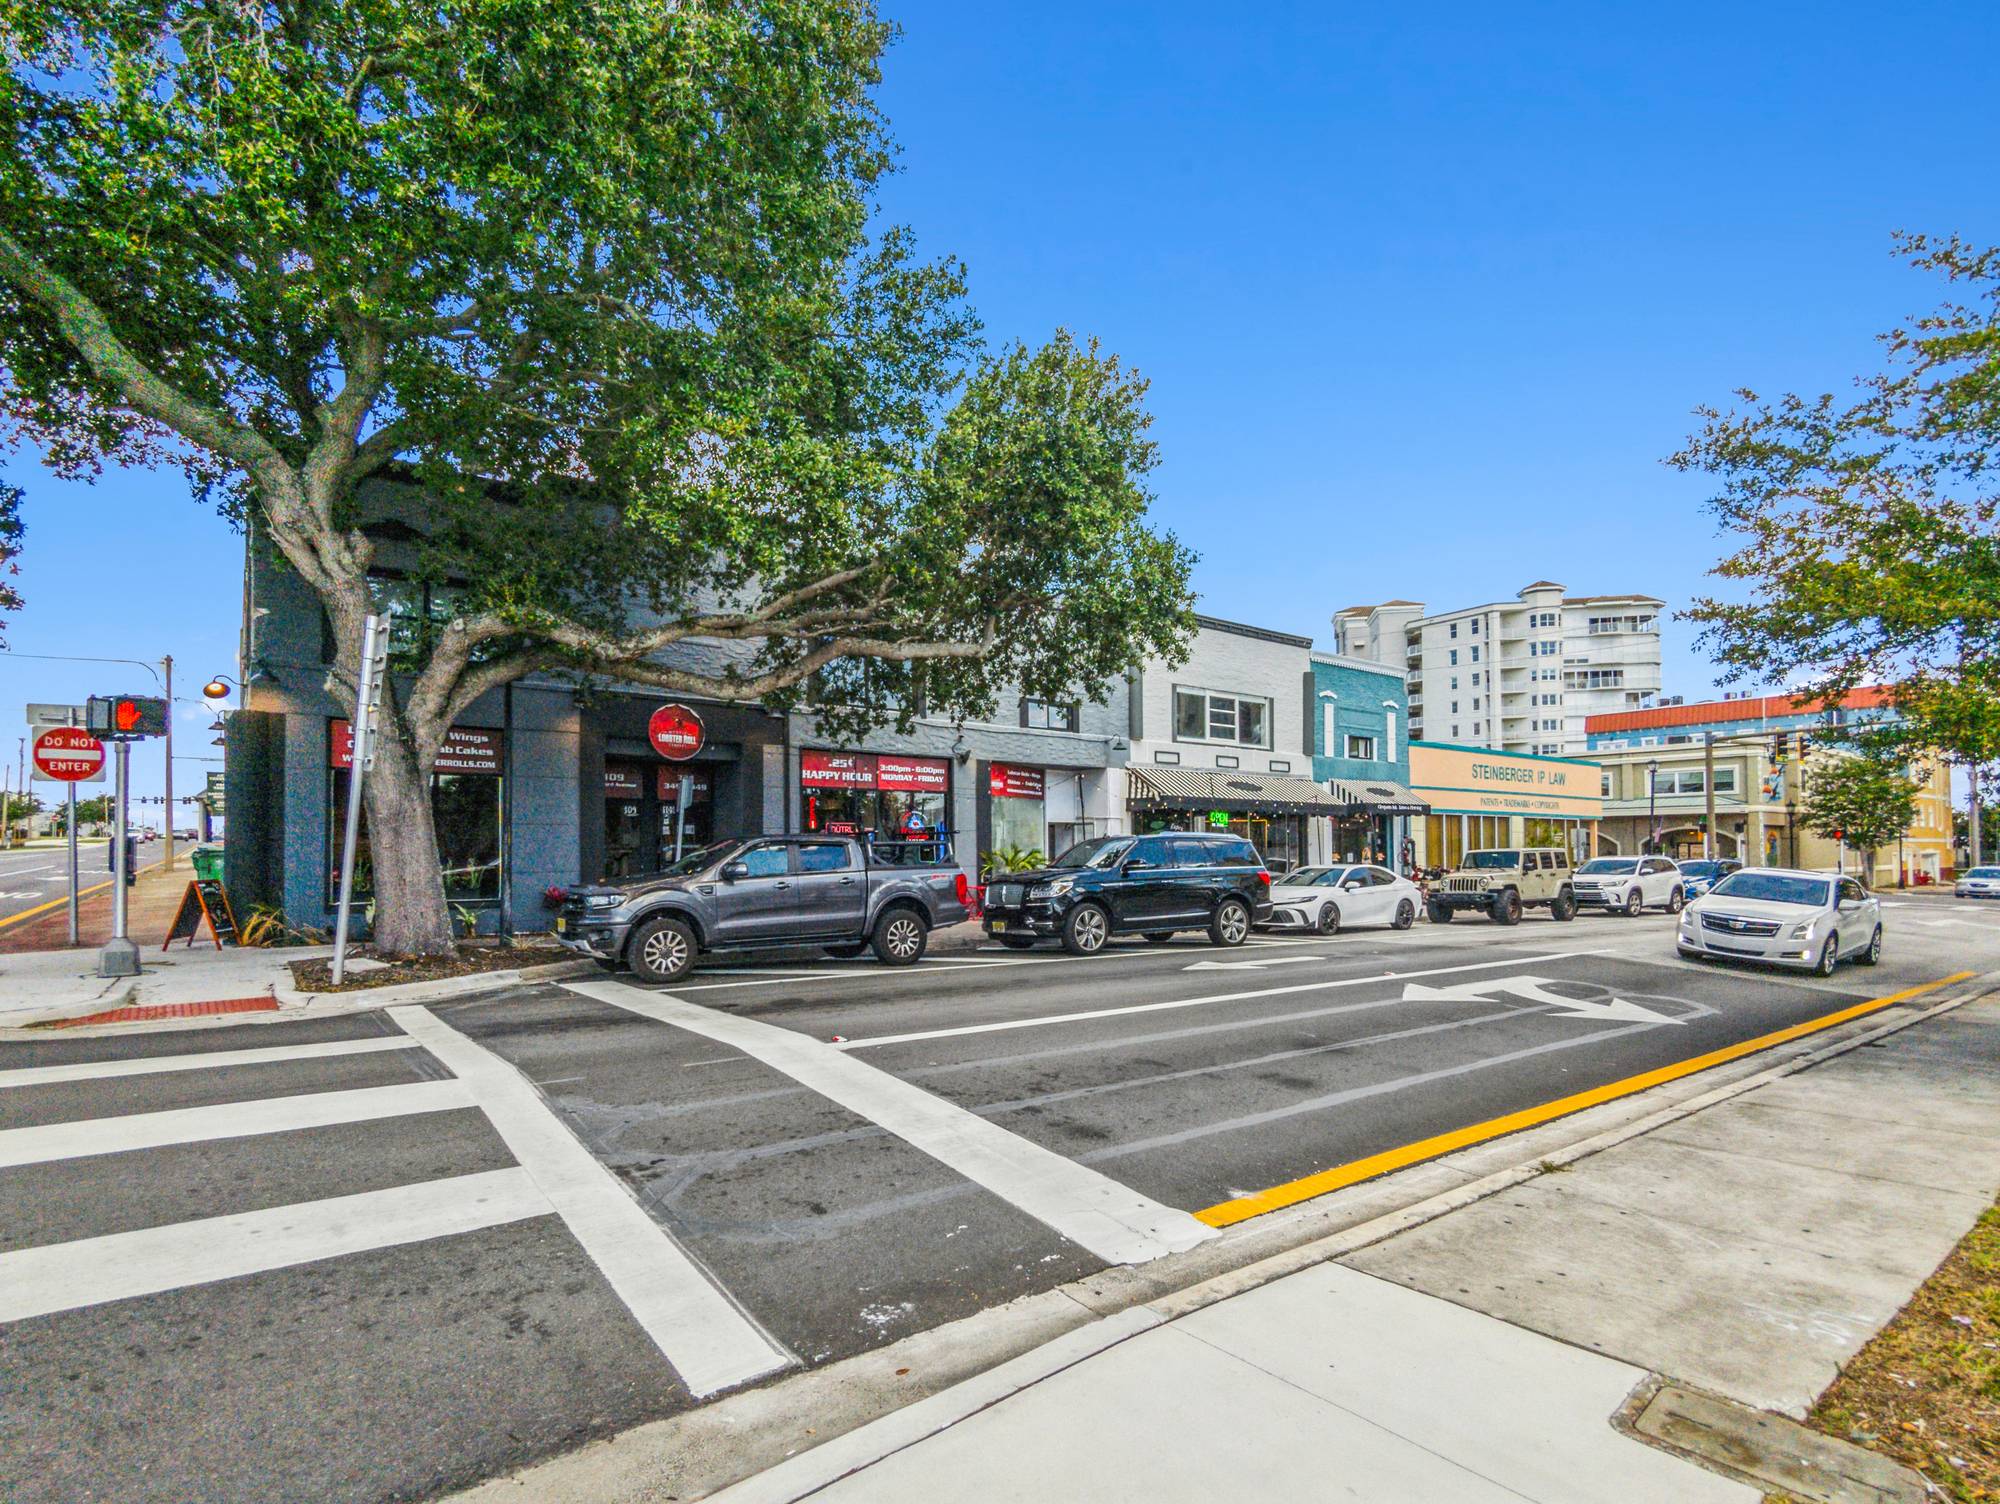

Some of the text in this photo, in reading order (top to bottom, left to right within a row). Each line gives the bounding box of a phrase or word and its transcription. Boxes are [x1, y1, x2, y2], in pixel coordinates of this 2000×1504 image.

[45, 736, 95, 748] DO NOT
[449, 732, 489, 743] Wings
[439, 745, 494, 756] ab Cakes
[49, 761, 90, 771] ENTER
[435, 759, 496, 769] ERROLLS.COM
[880, 764, 911, 773] 3:00pm
[915, 766, 945, 775] 6:00pm
[802, 769, 872, 782] HAPPY HOUR
[881, 773, 913, 781] MONDAY
[918, 775, 944, 783] FRIDAY
[1472, 764, 1566, 786] STEINBERGER IP LAW
[1210, 811, 1229, 824] OPEN
